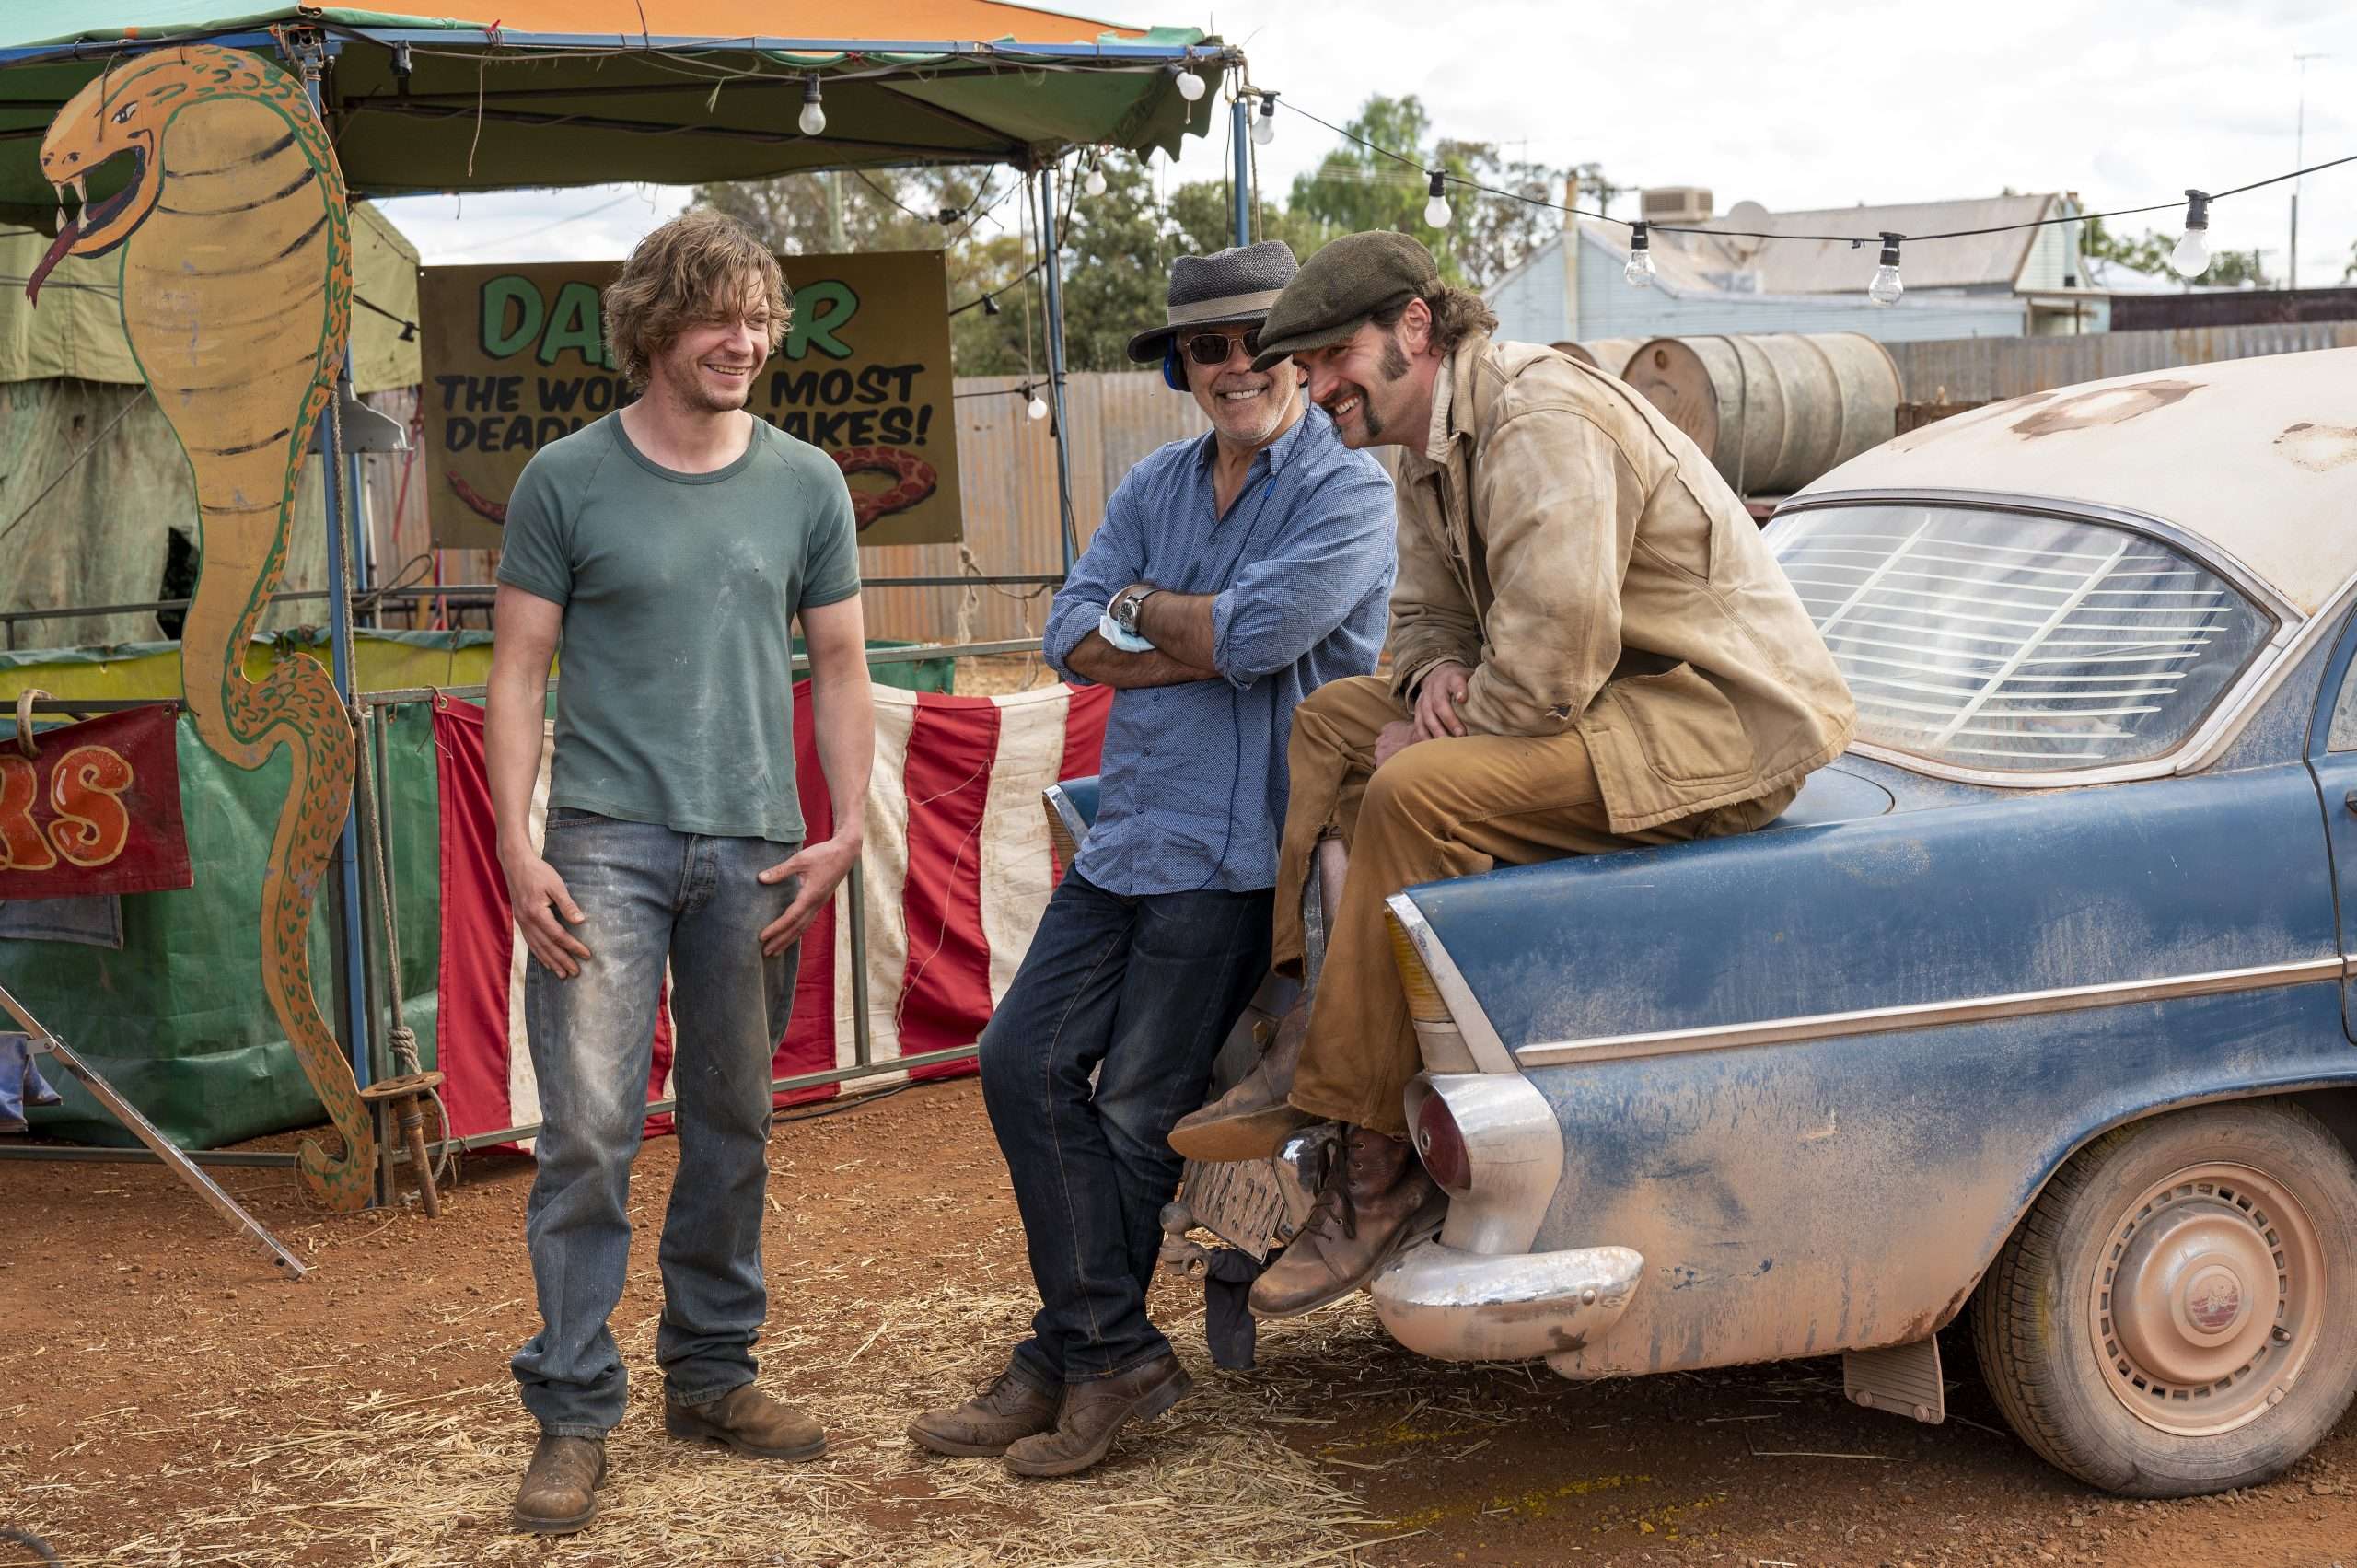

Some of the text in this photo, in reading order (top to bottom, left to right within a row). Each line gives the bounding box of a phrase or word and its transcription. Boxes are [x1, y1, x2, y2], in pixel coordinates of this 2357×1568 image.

[480, 273, 860, 372] DAR
[434, 375, 524, 412] THE
[770, 364, 925, 408] MOST
[764, 404, 934, 447] AKES!
